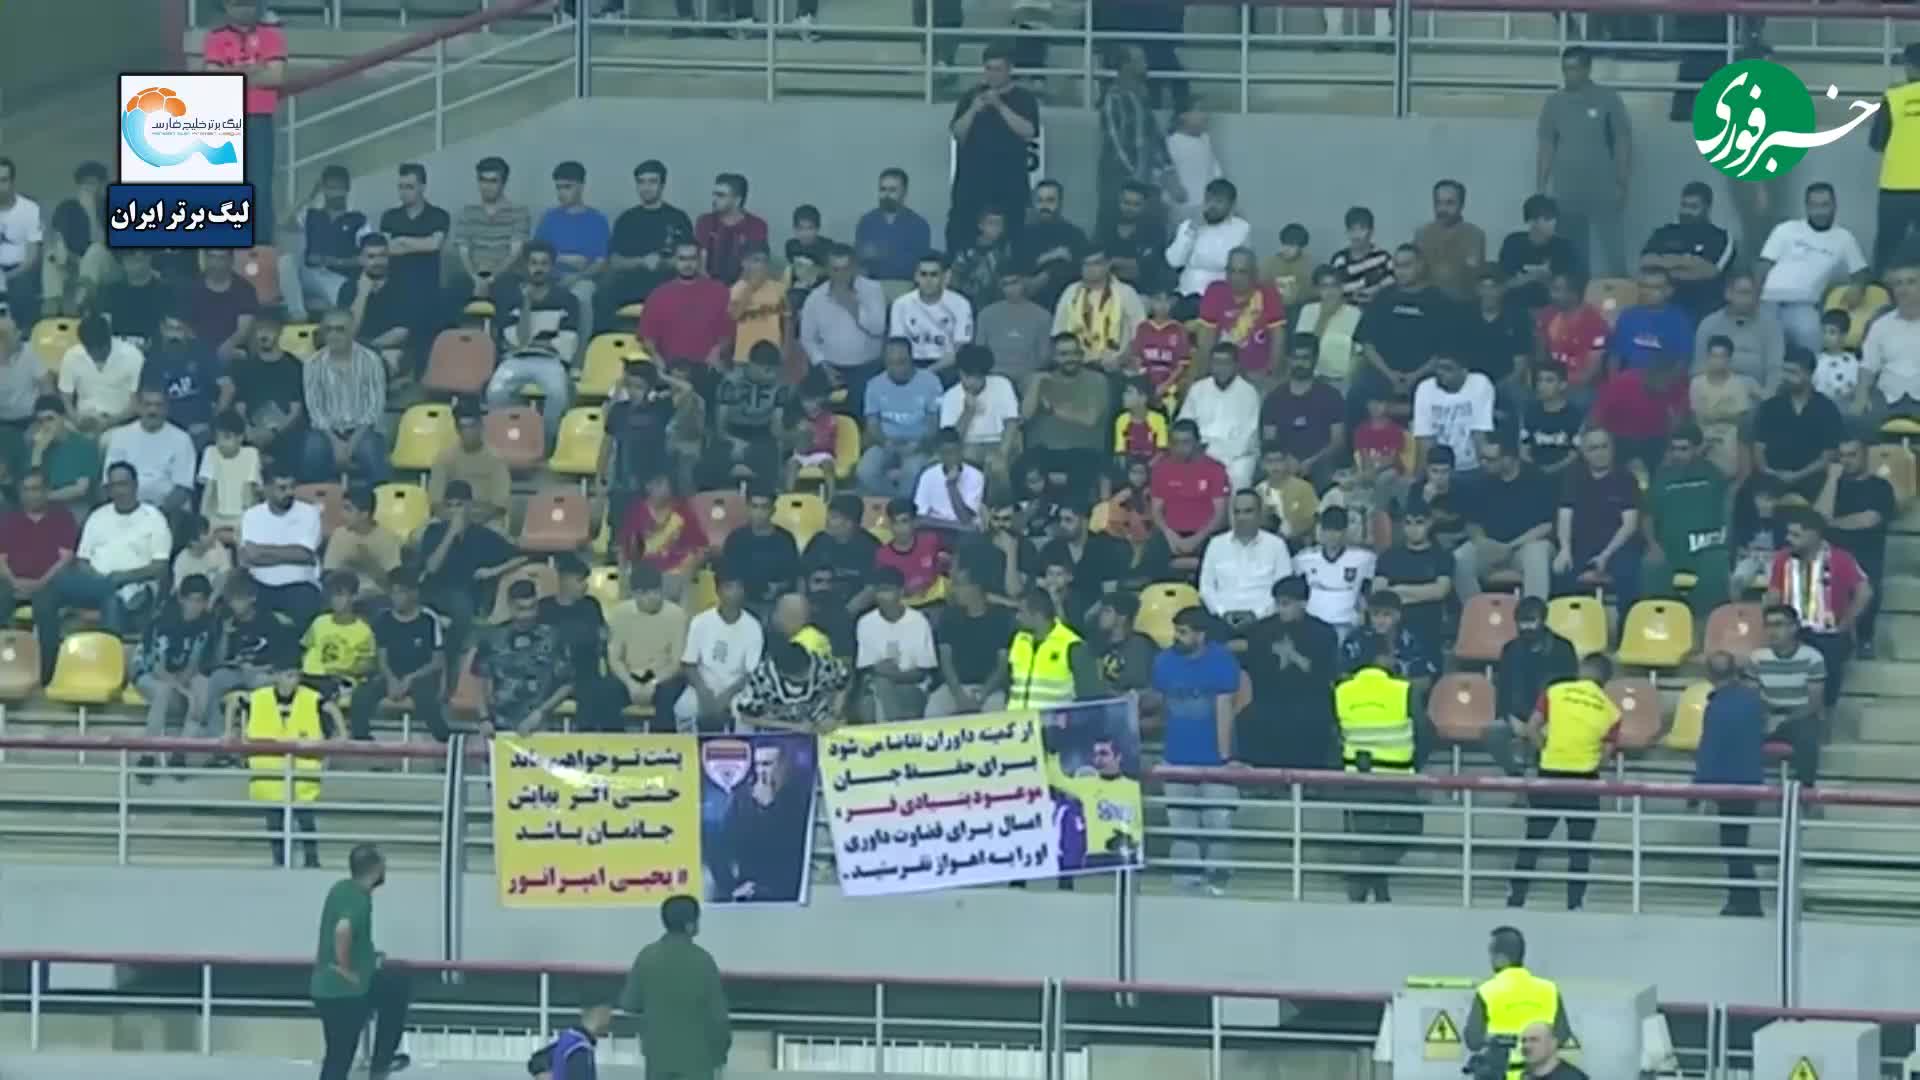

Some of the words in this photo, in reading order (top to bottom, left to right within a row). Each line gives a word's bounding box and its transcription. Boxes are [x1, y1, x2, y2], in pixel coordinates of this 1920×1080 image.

[925, 728, 975, 752] داوران
[548, 749, 607, 773] خواهی
[611, 747, 640, 773] تو
[644, 748, 682, 771] پشت
[904, 758, 975, 780] حفظ
[977, 756, 1038, 777] برای
[833, 768, 901, 792] جان
[570, 783, 608, 810] اگر
[613, 786, 680, 809] حتی
[516, 820, 582, 844] باشد
[586, 819, 674, 845] جانمان
[844, 829, 891, 854] داوری
[894, 821, 943, 848] قضاوت
[946, 820, 993, 843] برای
[936, 849, 985, 876] اهواز
